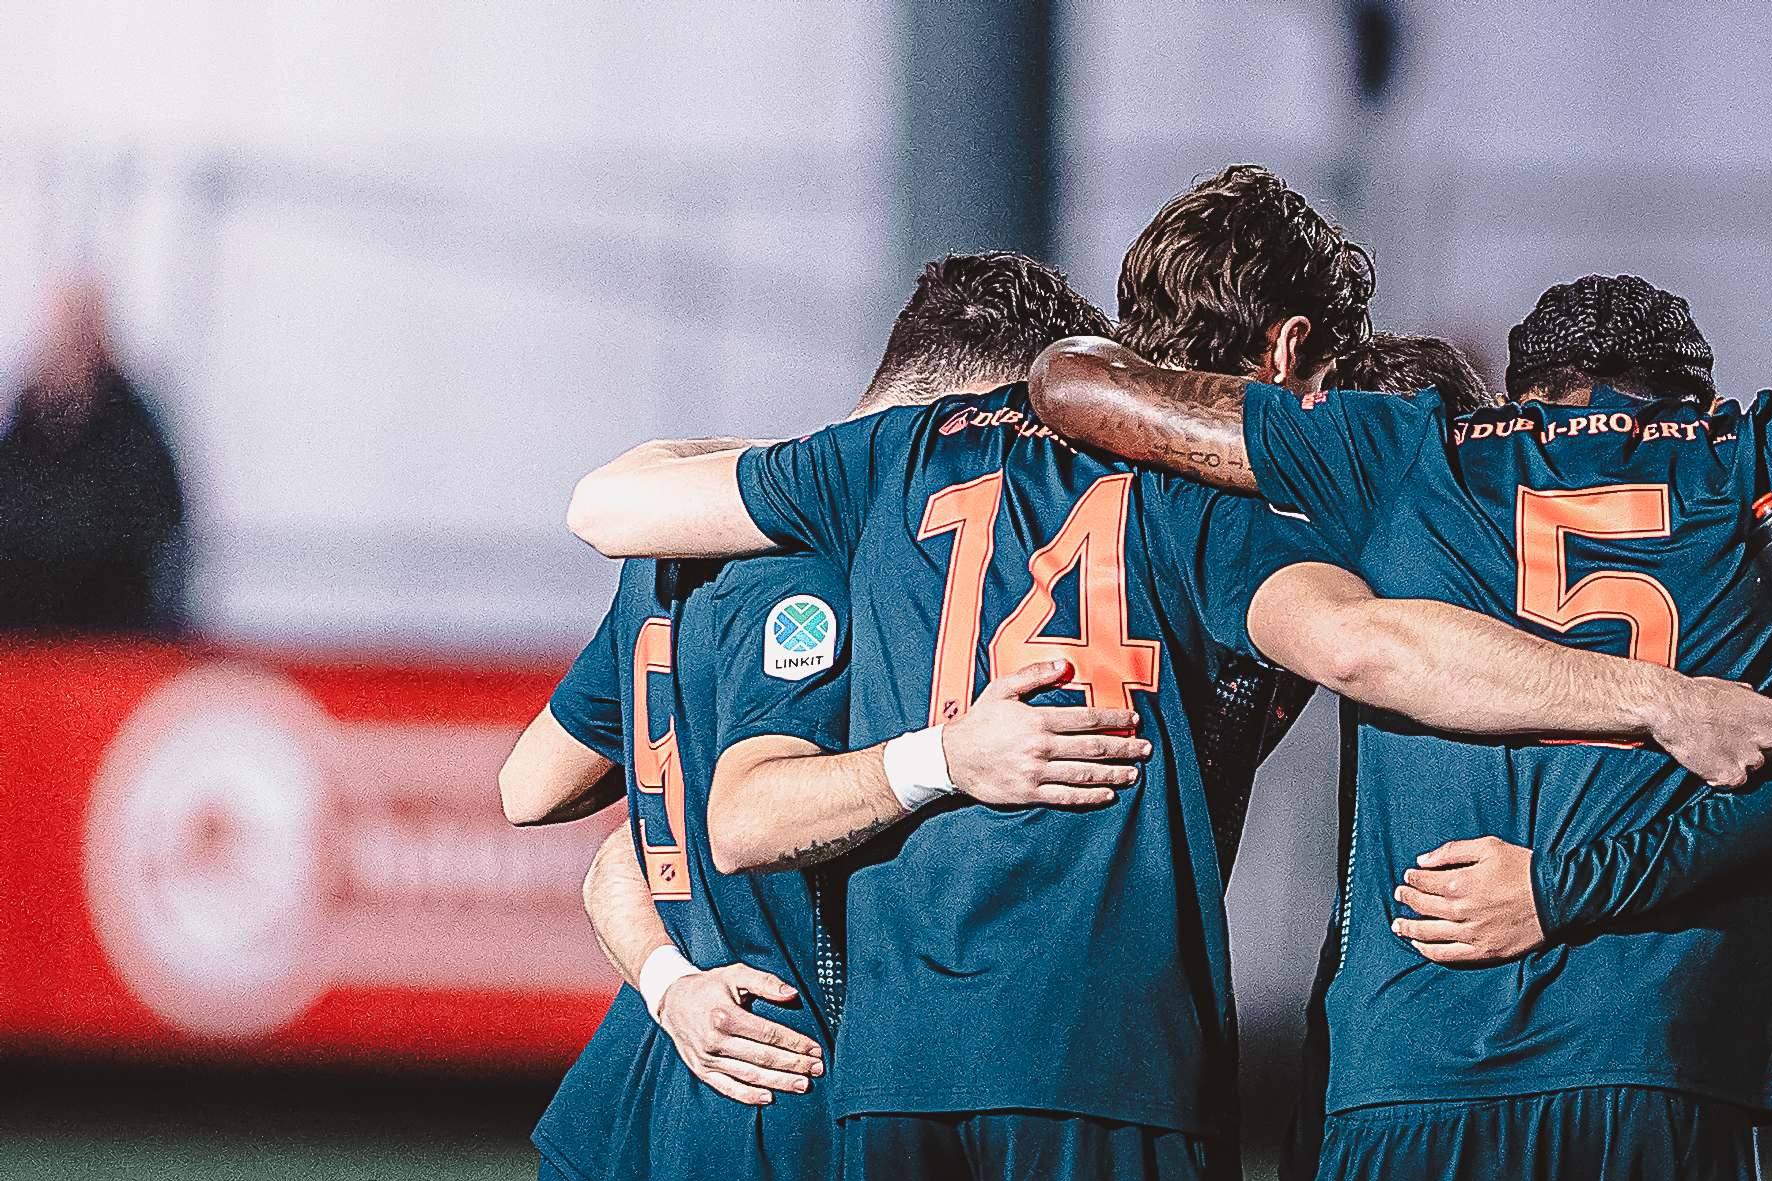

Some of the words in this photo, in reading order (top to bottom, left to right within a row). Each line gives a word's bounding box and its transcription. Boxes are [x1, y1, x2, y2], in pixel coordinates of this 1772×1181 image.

[774, 655, 825, 670] LINKIT
[917, 469, 1161, 738] 14
[1517, 484, 1679, 750] 5
